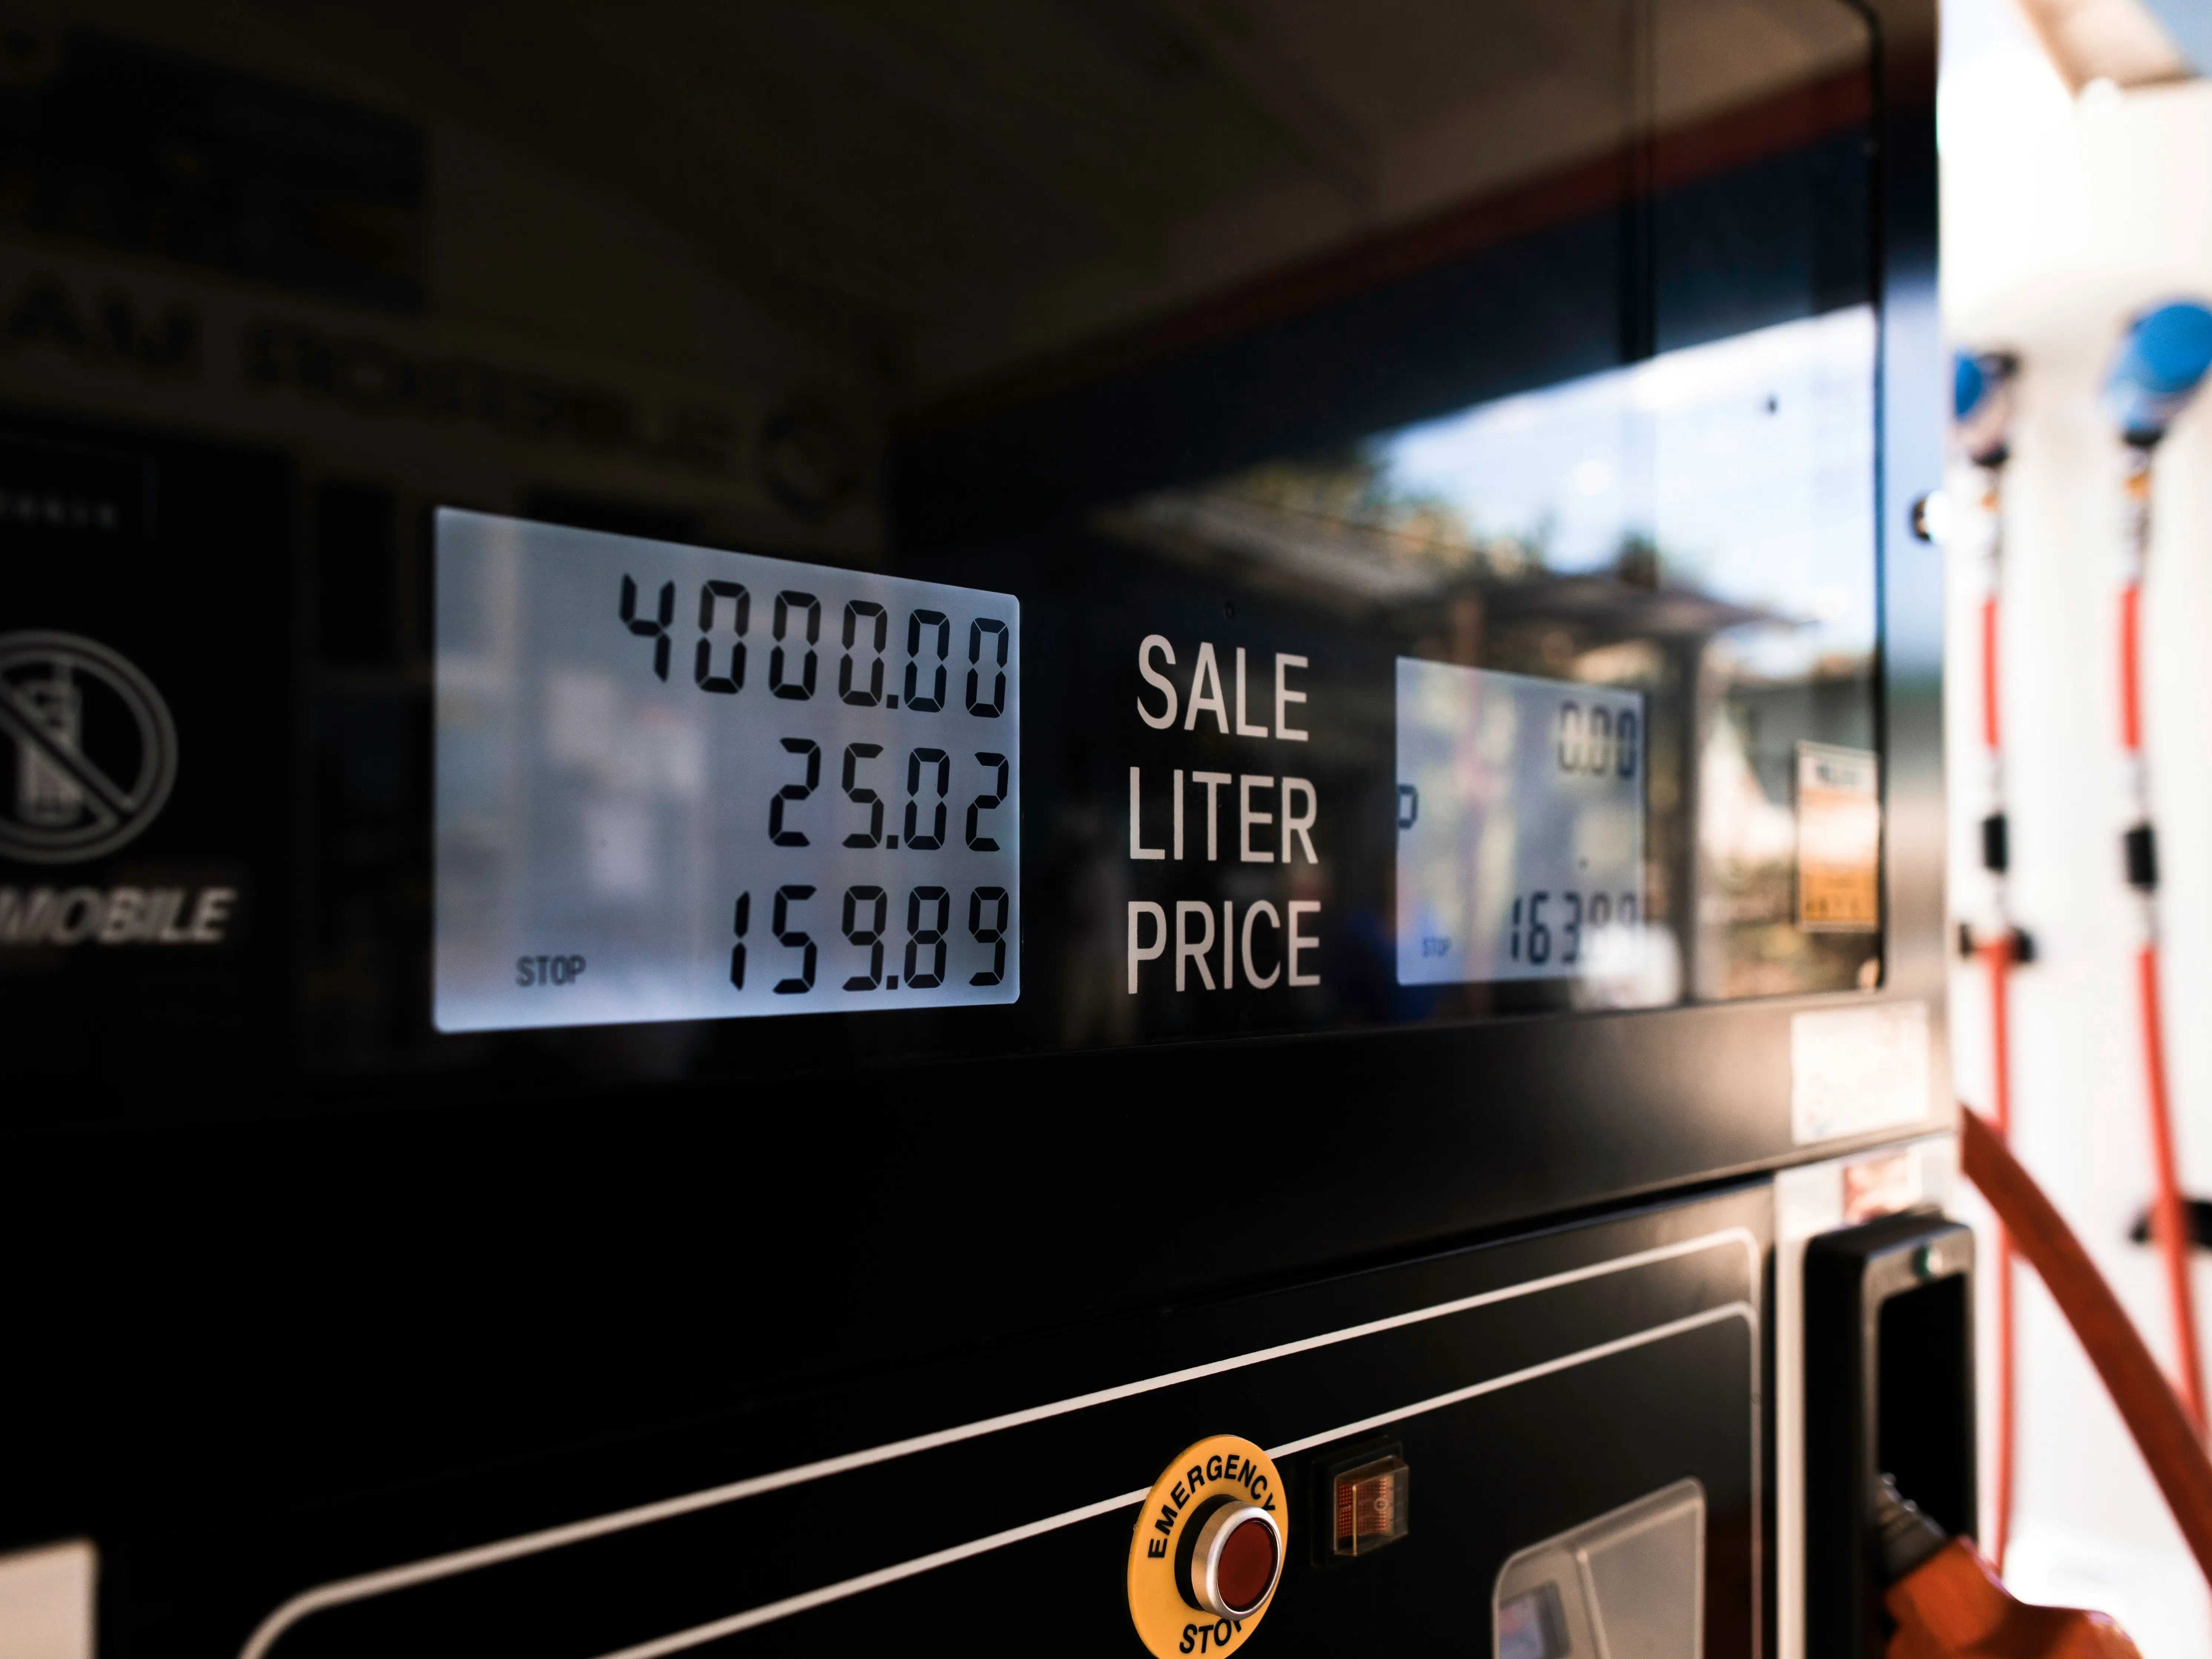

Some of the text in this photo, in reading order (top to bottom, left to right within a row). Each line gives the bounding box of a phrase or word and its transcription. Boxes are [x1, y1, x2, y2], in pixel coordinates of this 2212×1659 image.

[619, 573, 1010, 718] 4000.00
[1138, 634, 1308, 741] SALE
[769, 738, 1010, 852] 25.02
[1130, 766, 1318, 864] LITER
[516, 955, 586, 988] STOP
[729, 885, 1010, 995] 159.89
[1128, 900, 1321, 994] PRICE
[1148, 1455, 1275, 1559] EMERGENCY
